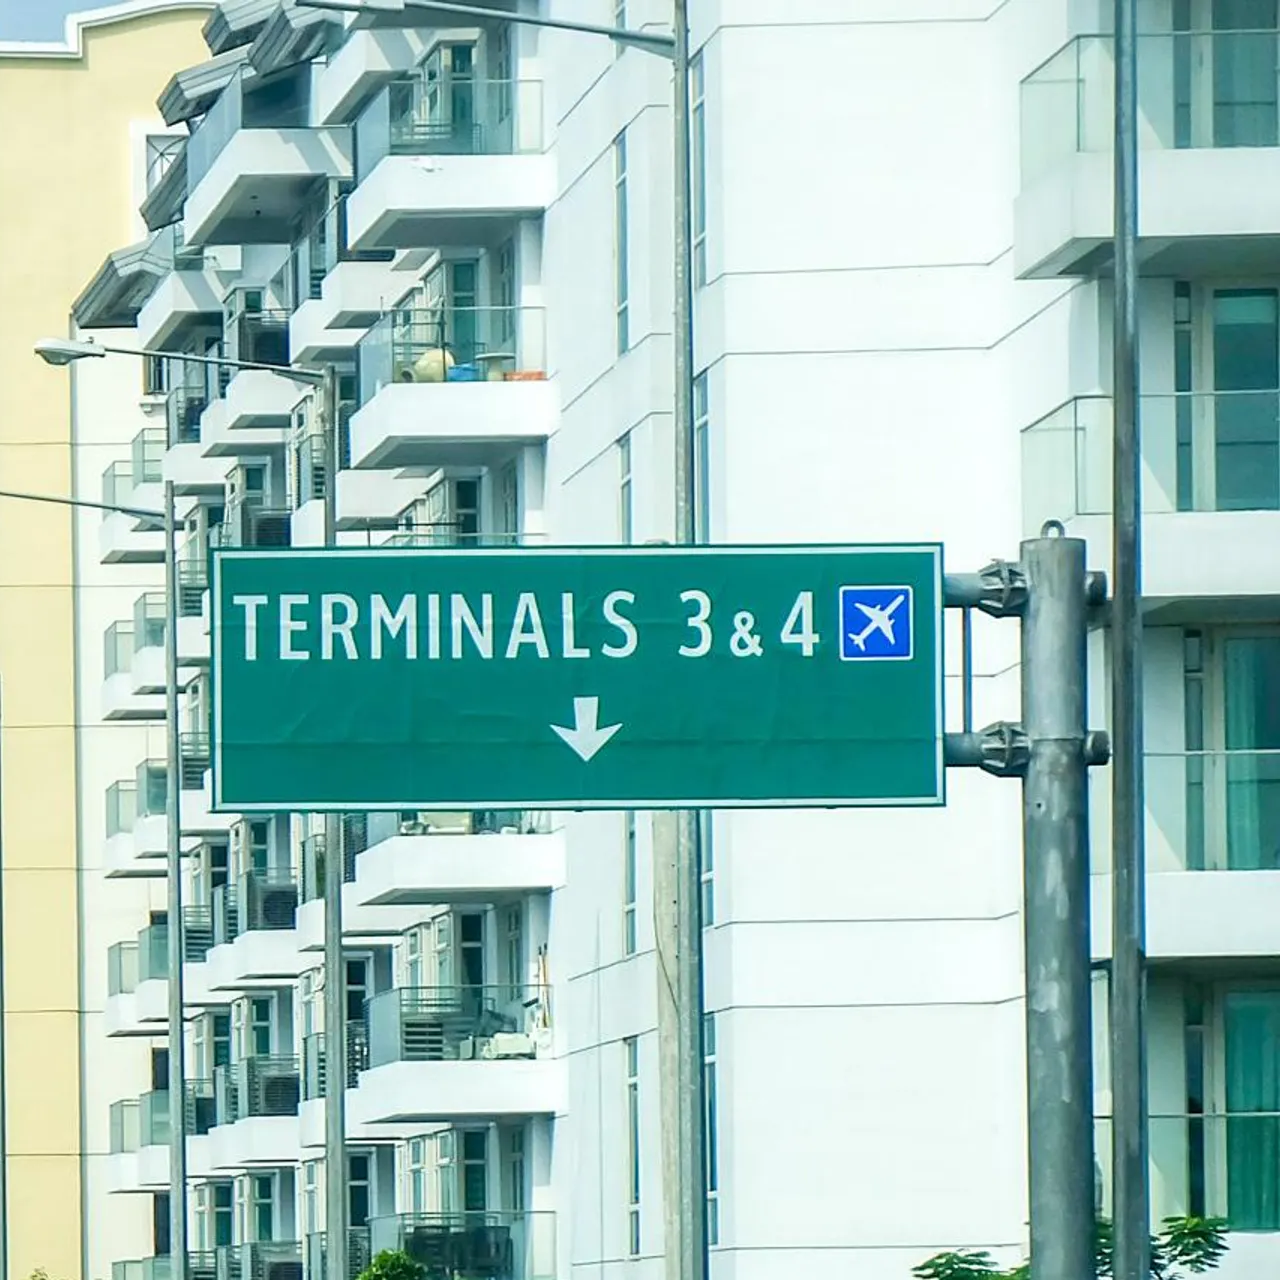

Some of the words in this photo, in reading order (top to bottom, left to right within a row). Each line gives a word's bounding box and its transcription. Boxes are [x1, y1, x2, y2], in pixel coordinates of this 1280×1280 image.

[232, 590, 639, 661] TERMINALS
[678, 590, 713, 658] 3
[729, 610, 763, 657] &
[780, 591, 821, 658] 4
